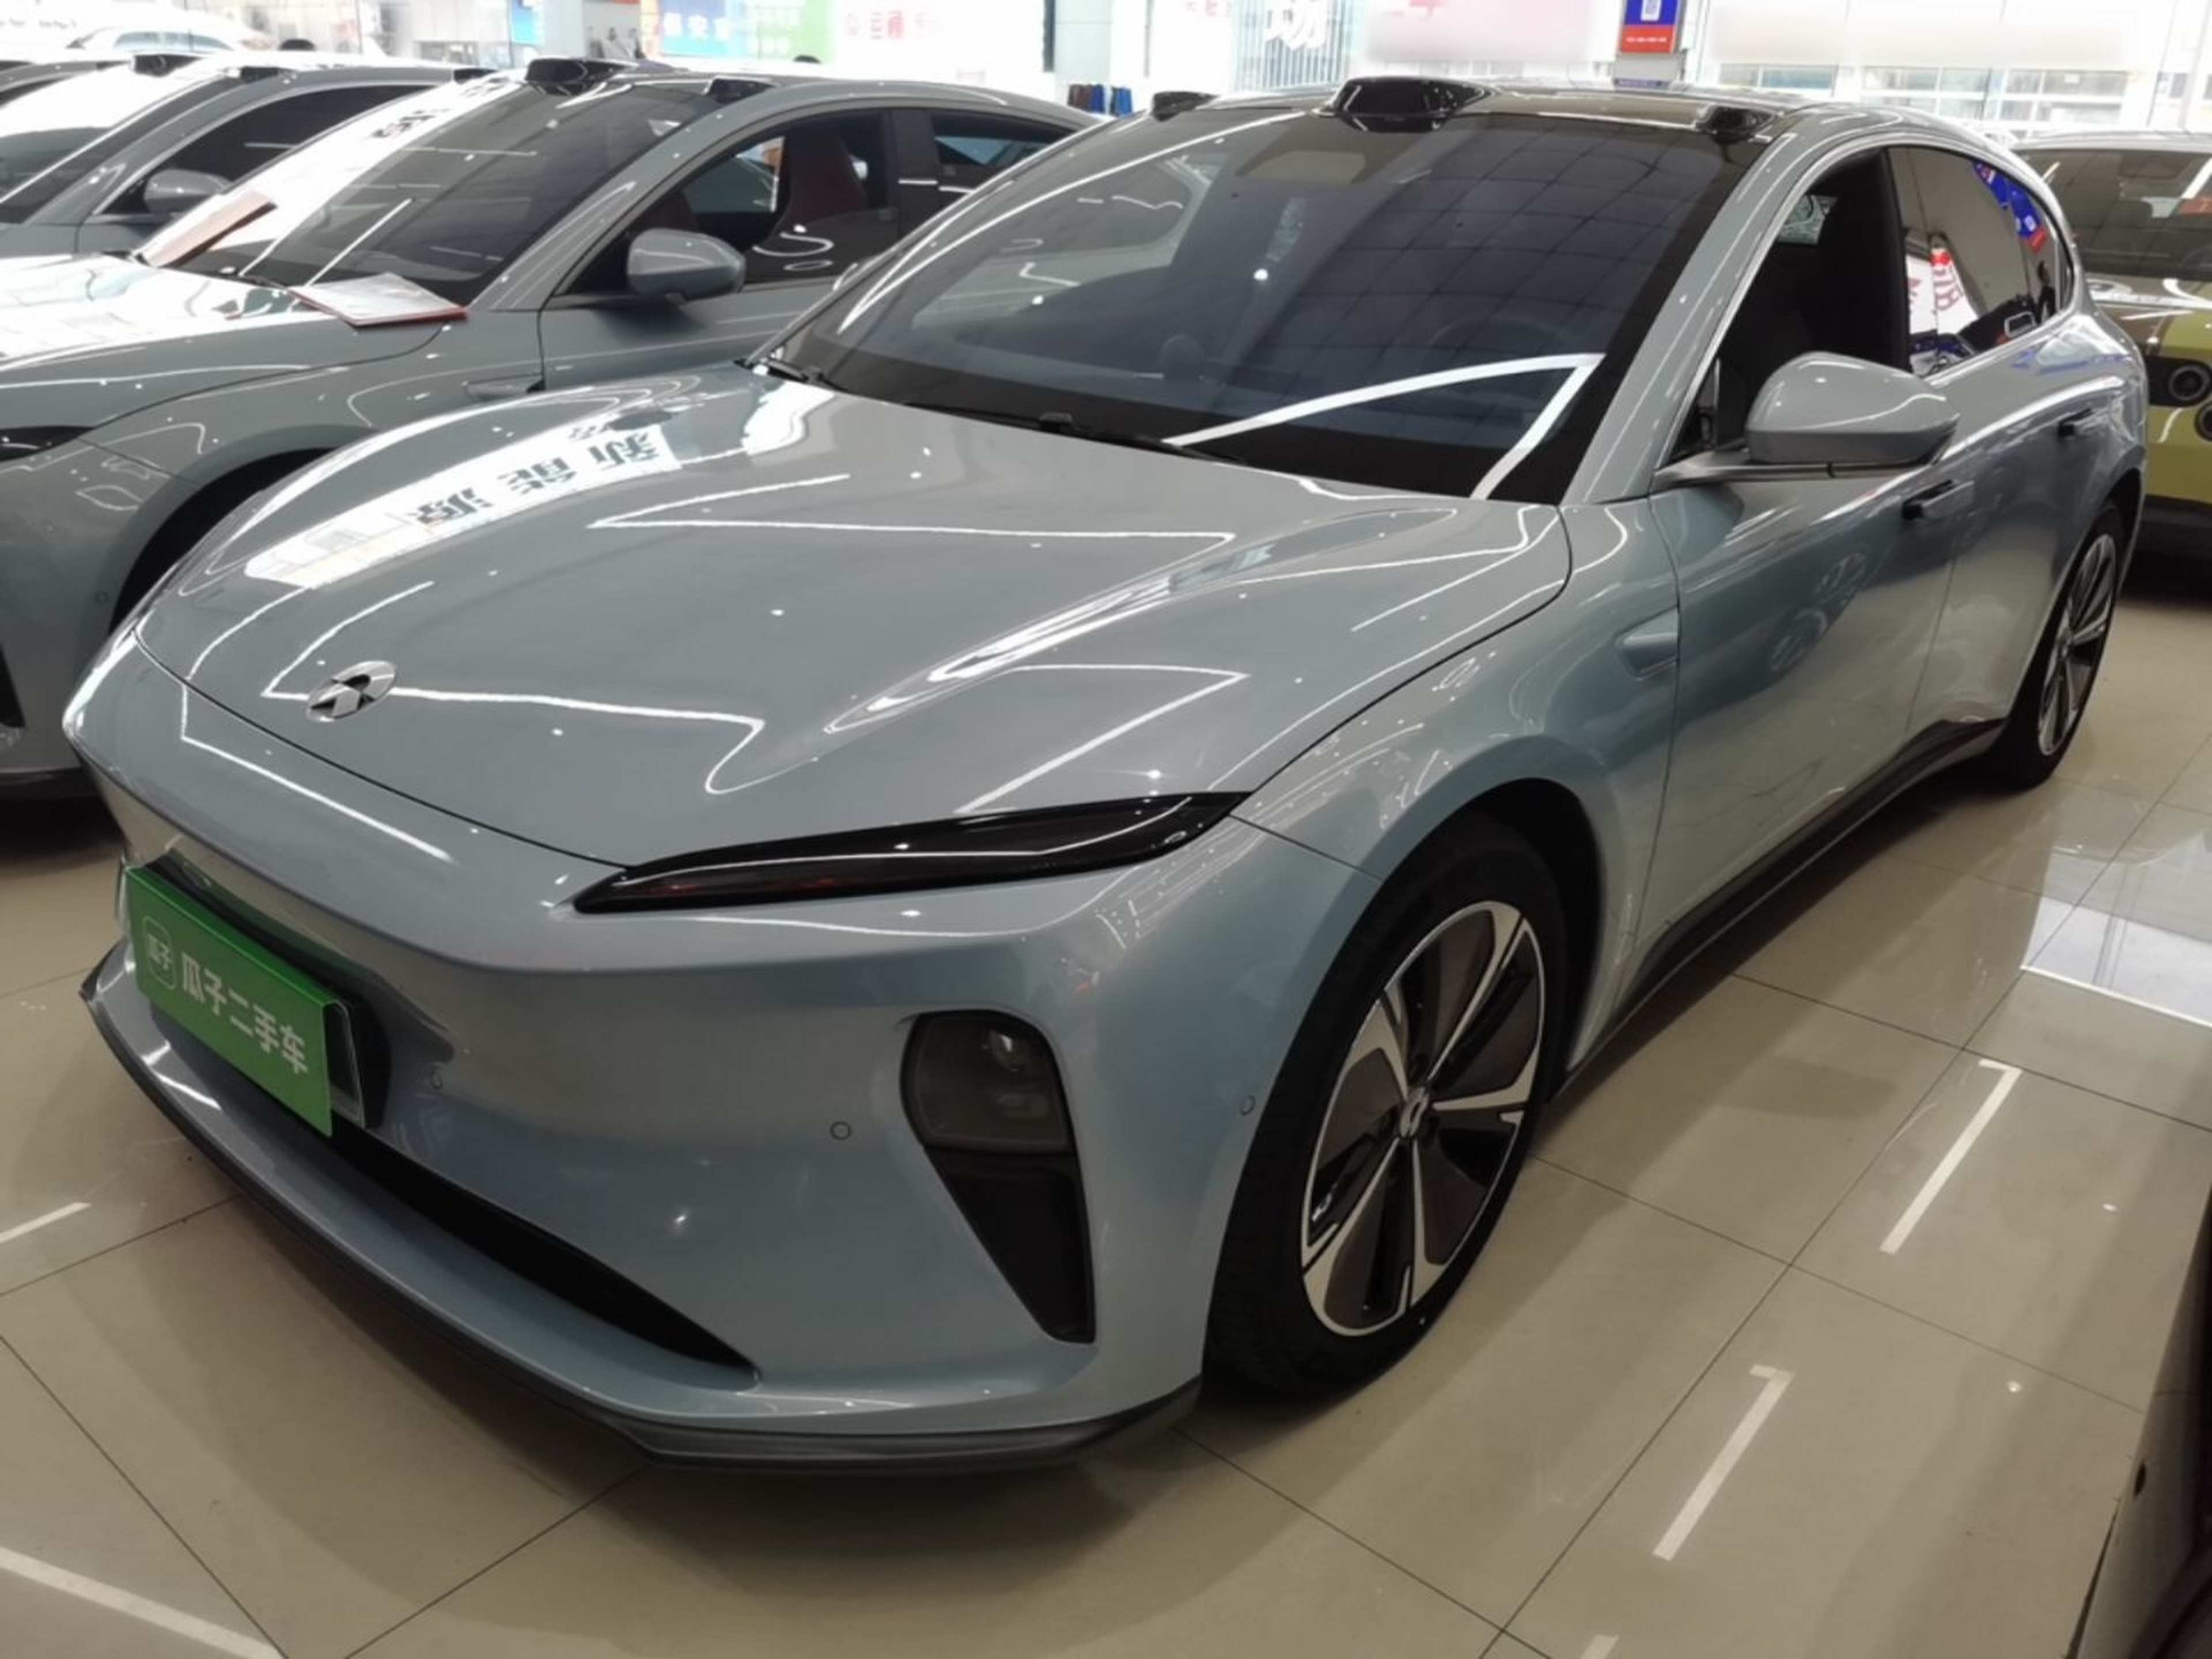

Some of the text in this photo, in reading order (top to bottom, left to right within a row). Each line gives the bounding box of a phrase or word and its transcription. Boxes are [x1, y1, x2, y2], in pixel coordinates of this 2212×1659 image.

[181, 952, 308, 1074] 瓜子二手车
